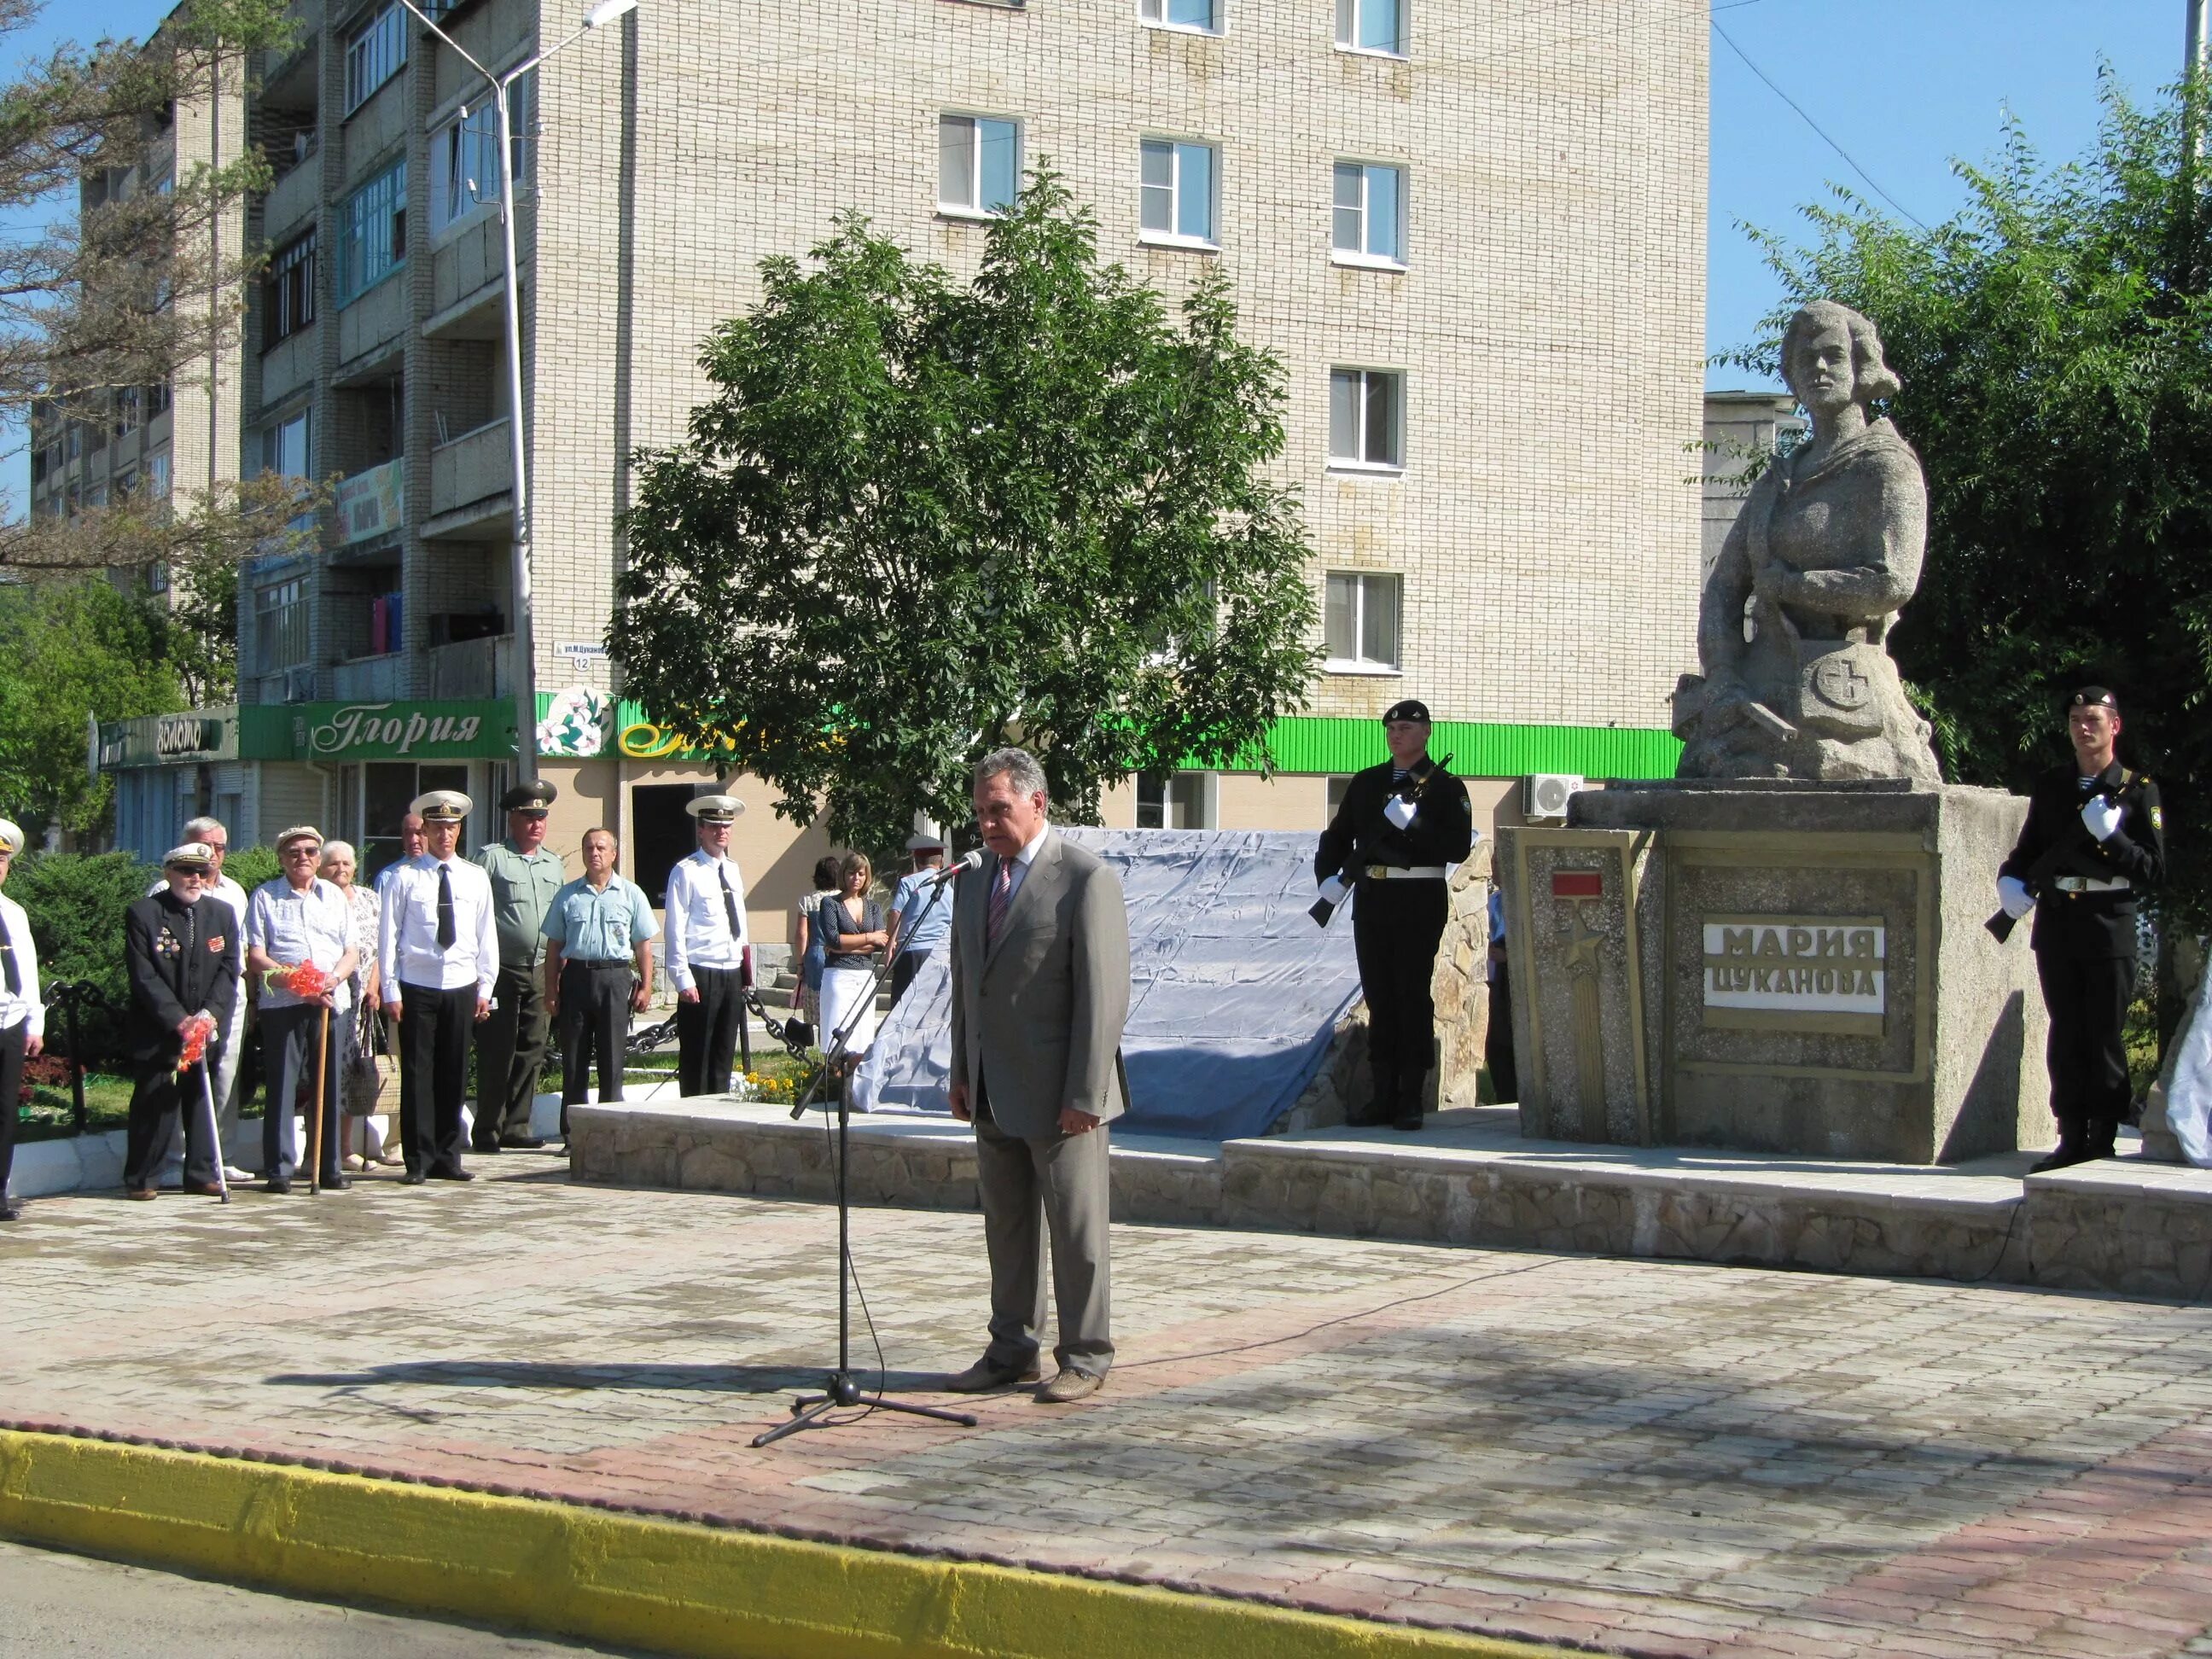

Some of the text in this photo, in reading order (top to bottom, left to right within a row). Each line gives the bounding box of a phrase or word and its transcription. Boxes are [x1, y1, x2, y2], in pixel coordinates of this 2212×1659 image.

[576, 658, 588, 668] 12
[312, 702, 480, 754] Глория
[1722, 928, 1875, 958] МАРИЯ
[1712, 967, 1877, 996] ЦУКАНОВА
